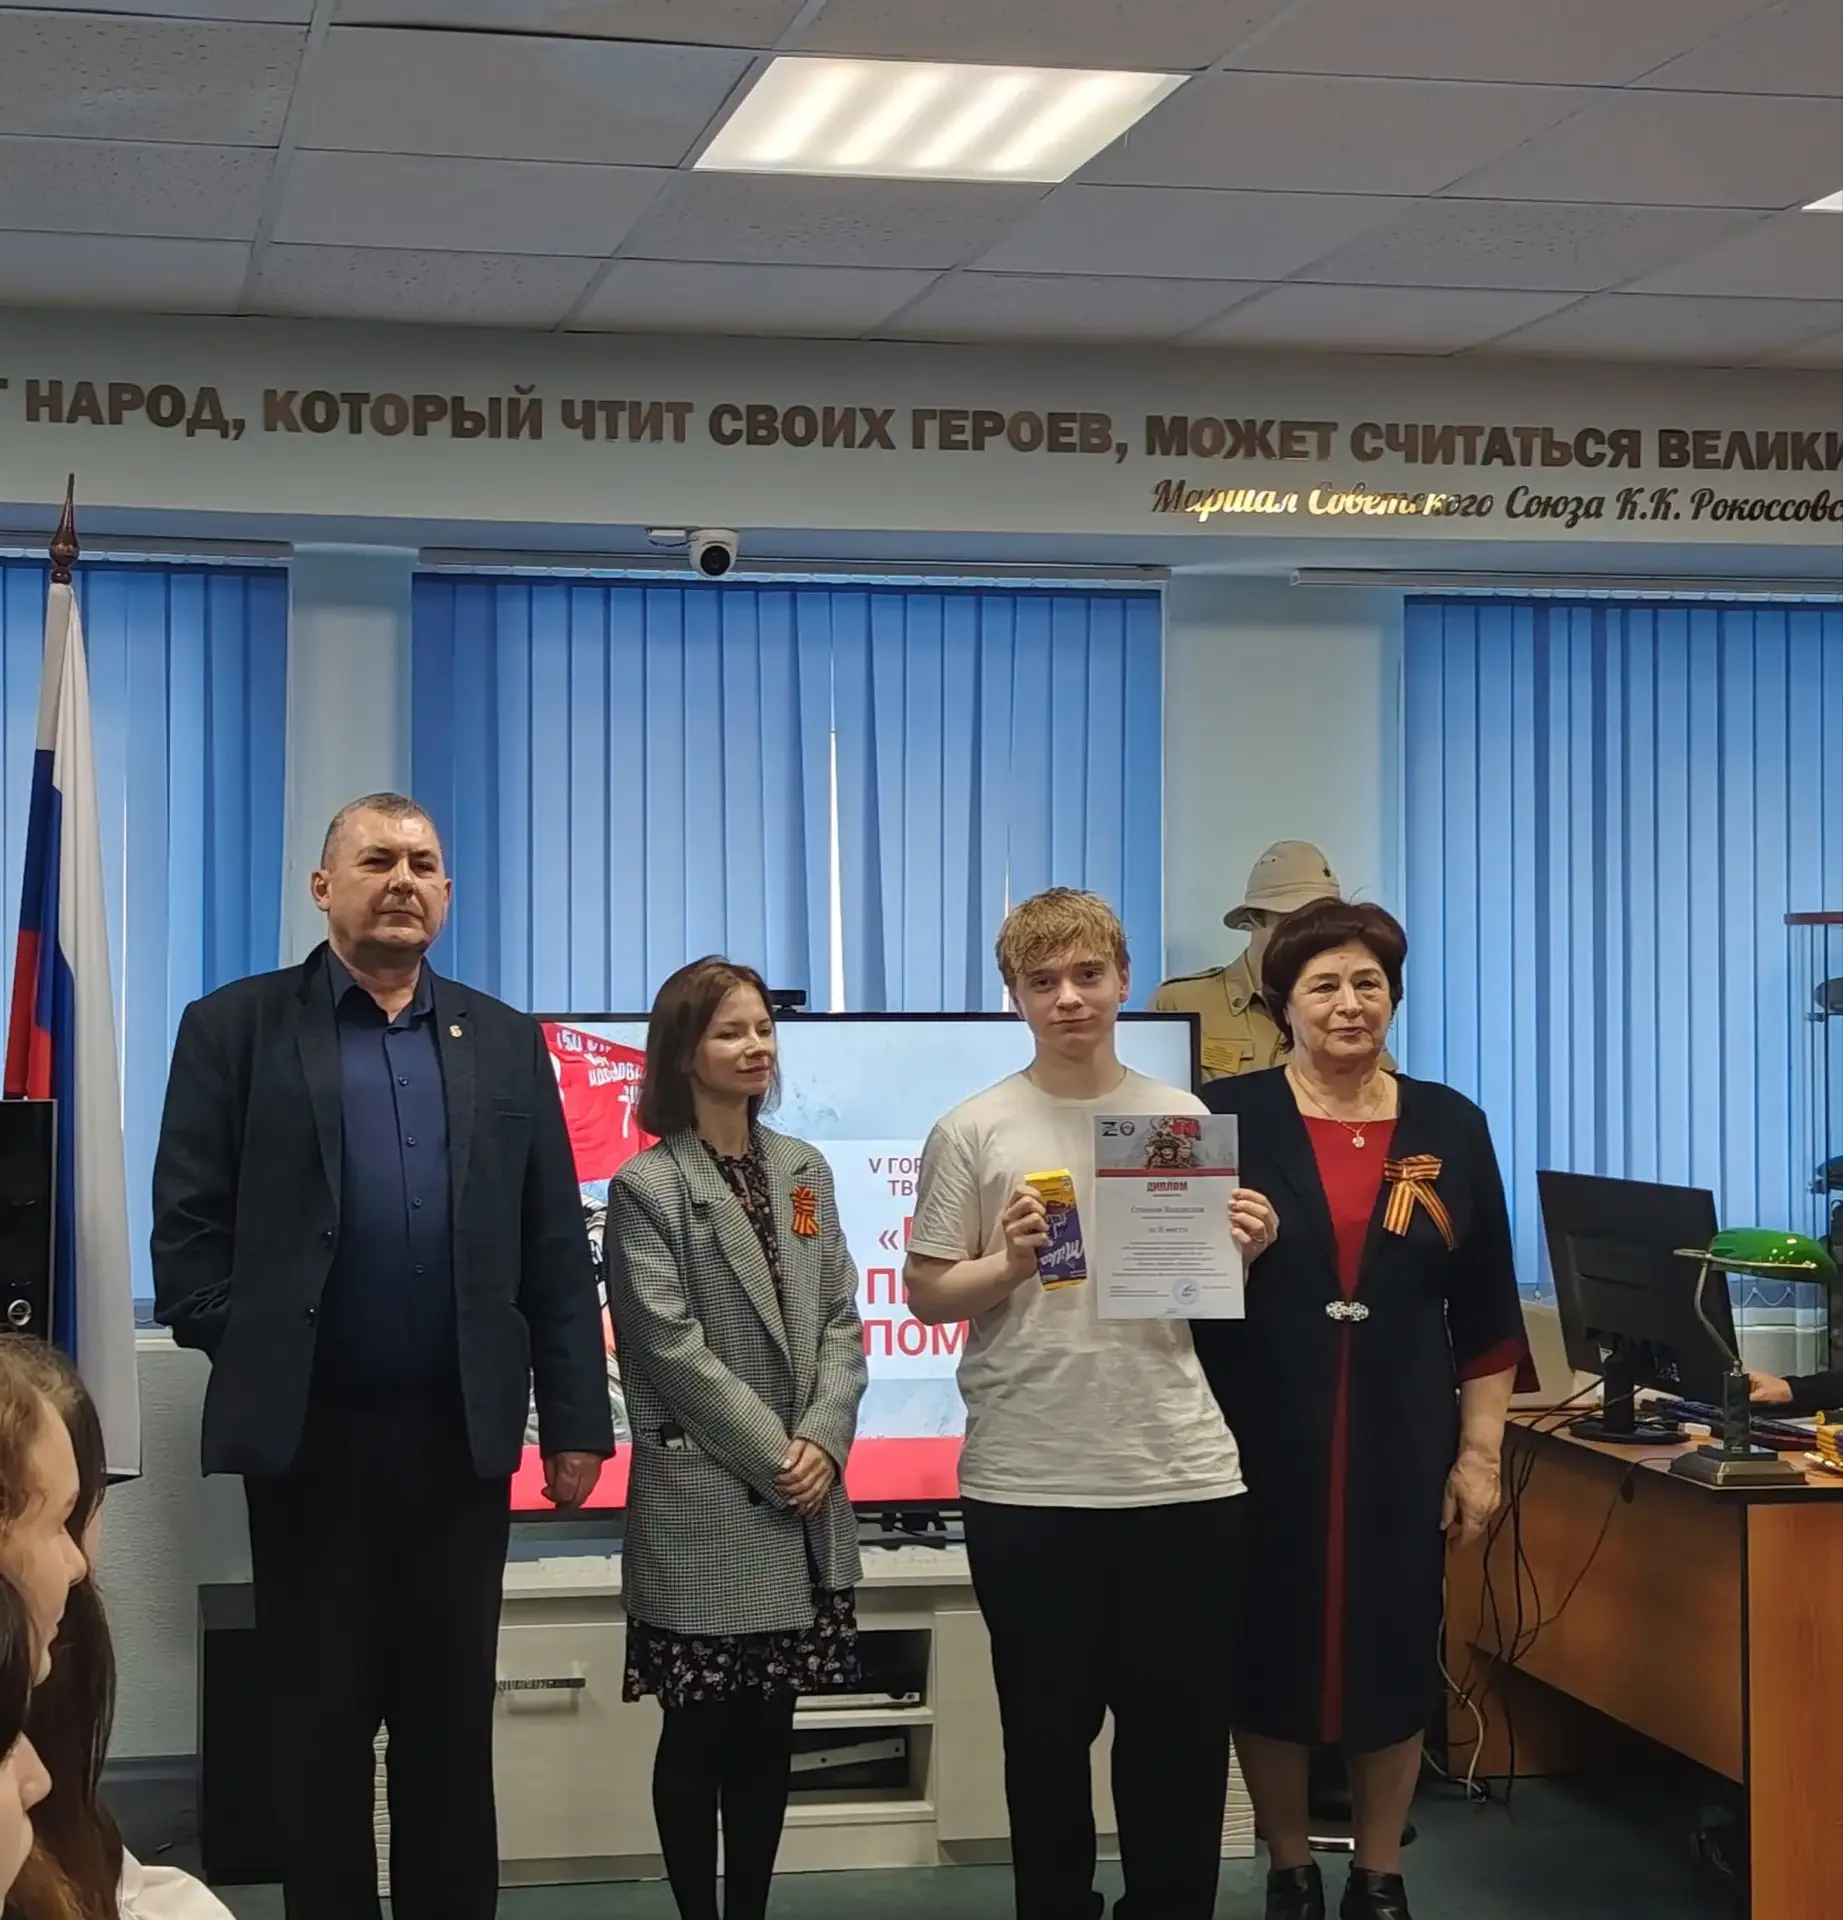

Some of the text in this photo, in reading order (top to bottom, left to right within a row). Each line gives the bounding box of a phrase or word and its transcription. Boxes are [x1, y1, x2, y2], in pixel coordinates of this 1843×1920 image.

[26, 379, 246, 441] НАРОД,
[263, 384, 543, 440] КОТОРЫЙ
[561, 399, 694, 443] ЧТИТ
[708, 404, 896, 449] СВОИХ
[911, 408, 1128, 464] ГЕРОЕВ,
[1145, 415, 1338, 461] МОЖЕТ
[1350, 422, 1642, 468] СЧИТАТЬСЯ
[1151, 479, 1298, 523] Маршал
[1307, 481, 1493, 519] Советского
[1506, 485, 1605, 528] Союза
[1617, 487, 1681, 520] К.К.
[868, 1158, 882, 1174] V
[887, 1180, 921, 1197] ТВ
[1040, 1240, 1084, 1267] Milka
[864, 1319, 970, 1357] ПОМ
